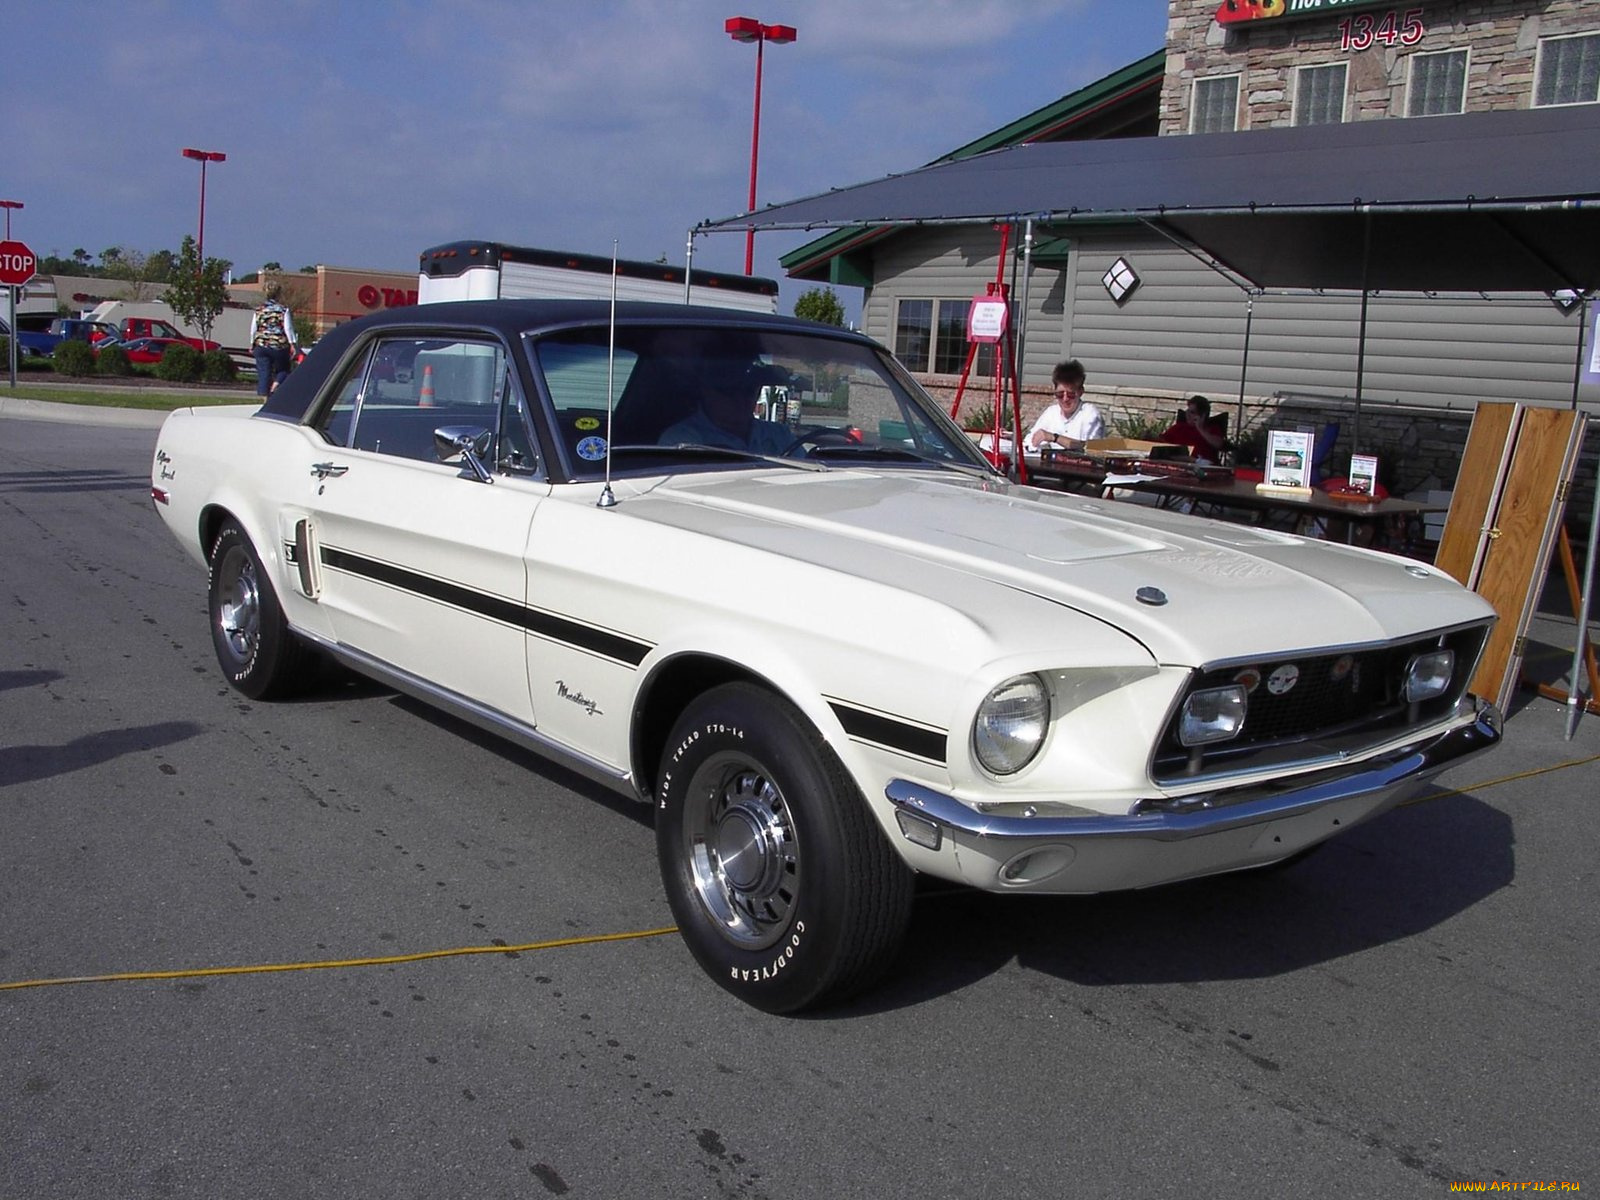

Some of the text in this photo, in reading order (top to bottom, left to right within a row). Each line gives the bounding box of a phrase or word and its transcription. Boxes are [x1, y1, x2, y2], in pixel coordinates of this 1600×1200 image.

[1338, 8, 1424, 51] 1345
[0, 254, 33, 272] TOP
[660, 724, 744, 809] WIDE TREAD F70-14
[731, 921, 805, 981] GOODYEAR
